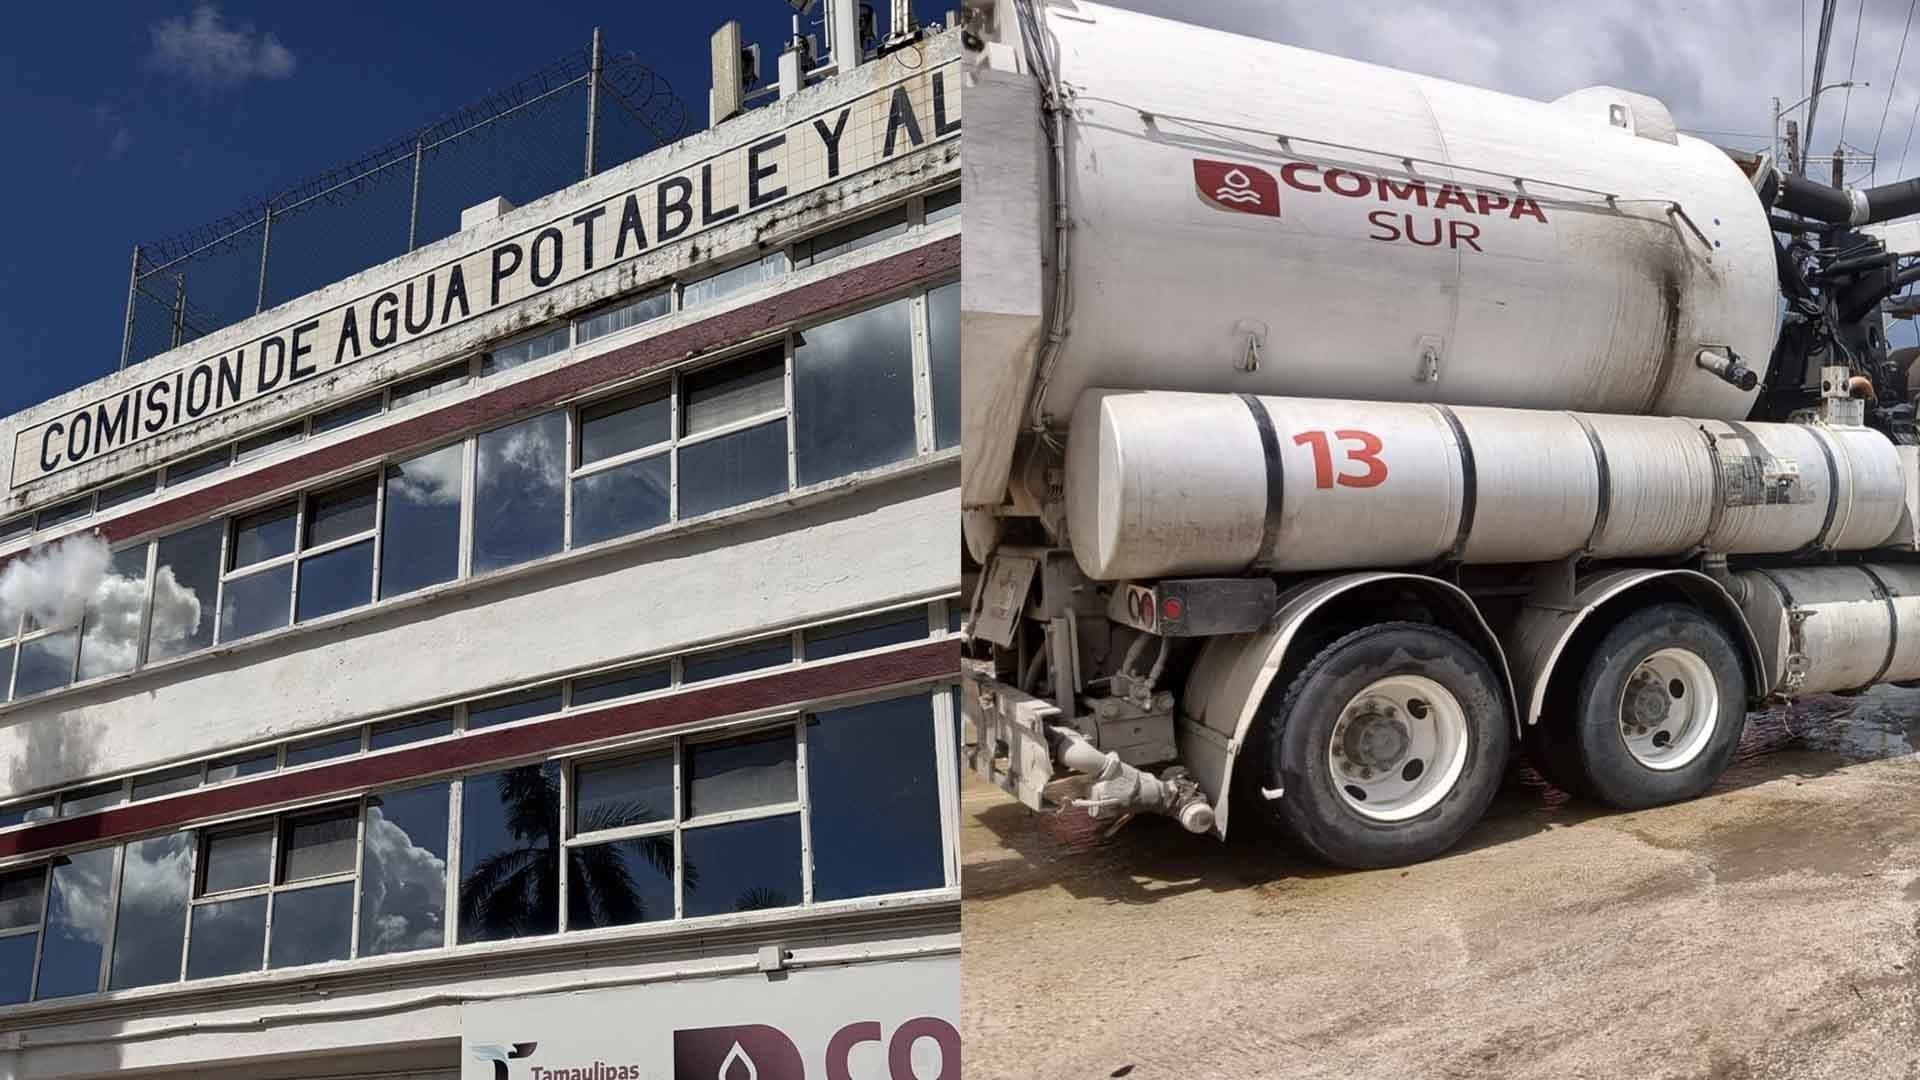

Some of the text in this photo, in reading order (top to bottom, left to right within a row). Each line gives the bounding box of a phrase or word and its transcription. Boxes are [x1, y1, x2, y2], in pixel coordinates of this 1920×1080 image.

[1280, 162, 1549, 224] COMAPA
[1368, 210, 1483, 252] SUR
[40, 350, 246, 472] COMISION
[257, 321, 319, 393] DE
[335, 264, 470, 364] AGUA
[491, 135, 787, 306] POTABLE
[814, 108, 851, 178] Y
[1293, 430, 1388, 489] 13
[531, 1062, 639, 1080] Tamaulipas
